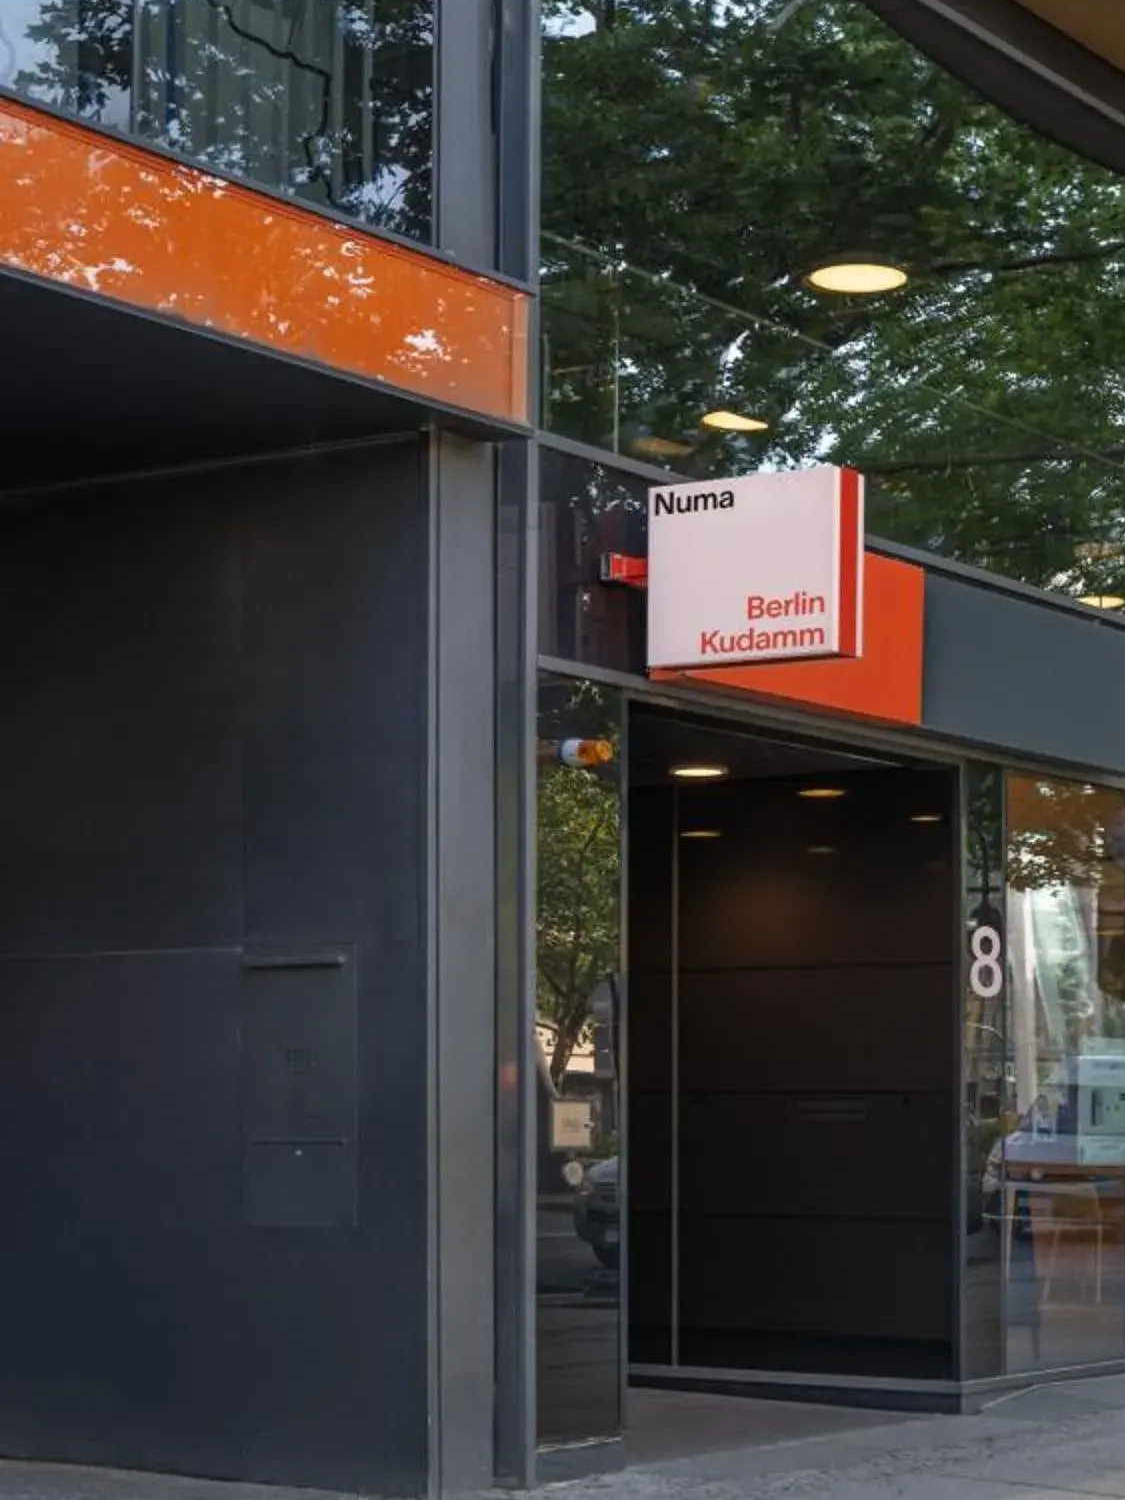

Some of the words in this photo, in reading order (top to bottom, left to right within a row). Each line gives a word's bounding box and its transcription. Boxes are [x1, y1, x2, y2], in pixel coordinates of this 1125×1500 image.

[654, 489, 735, 517] Numa
[746, 591, 825, 620] Berlin
[700, 626, 825, 655] Kudamm
[970, 925, 1002, 998] 8
